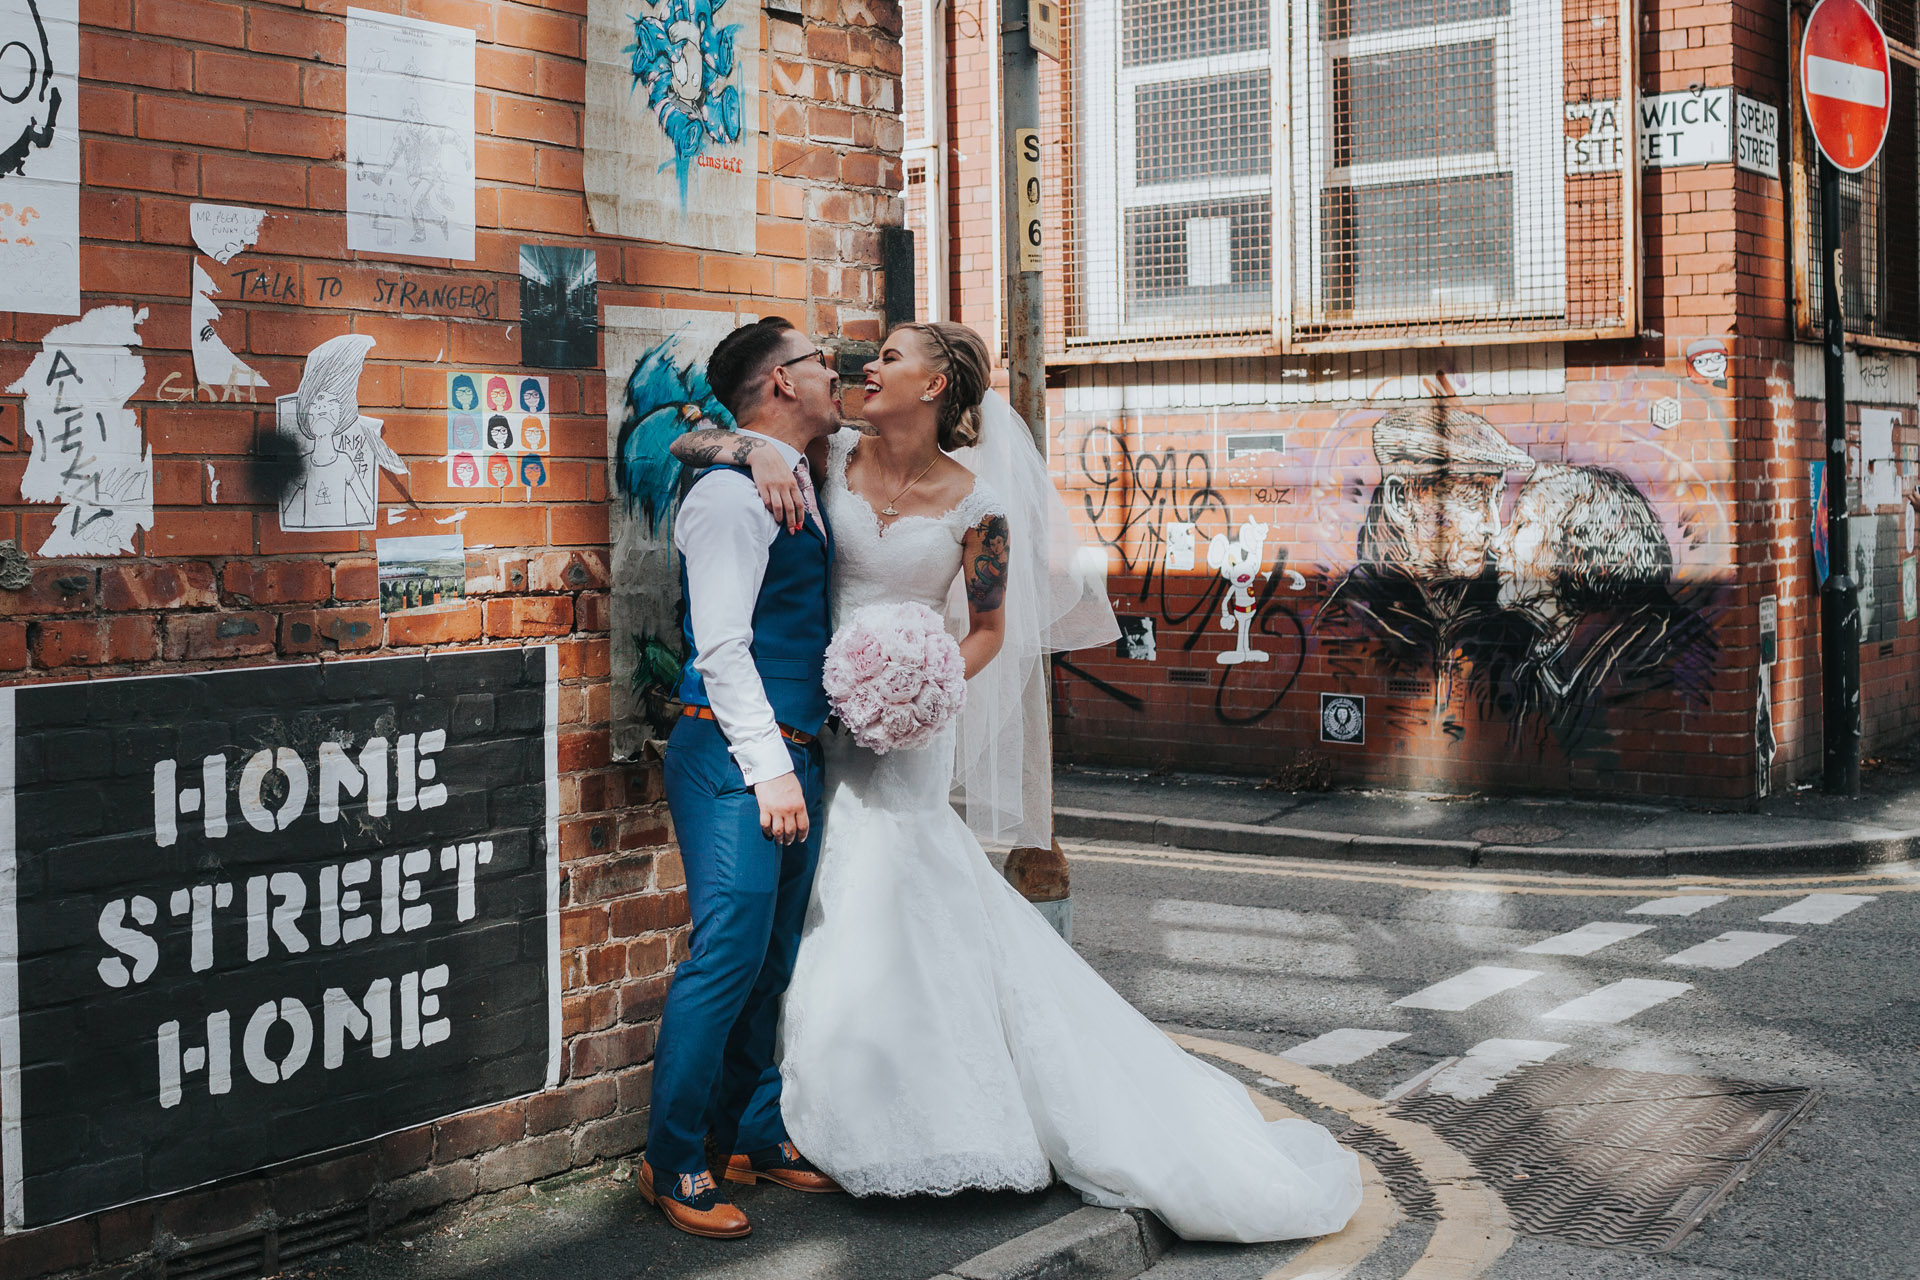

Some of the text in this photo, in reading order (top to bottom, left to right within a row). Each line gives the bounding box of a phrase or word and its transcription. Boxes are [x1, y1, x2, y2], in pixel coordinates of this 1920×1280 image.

[1740, 102, 1776, 138] SPEAR
[697, 151, 744, 174] dmstff
[1739, 133, 1776, 169] STREET
[231, 268, 496, 318] TALK TO STRANGERS
[153, 729, 448, 848] HOME
[97, 841, 493, 988] STREET
[157, 963, 451, 1109] HOME
